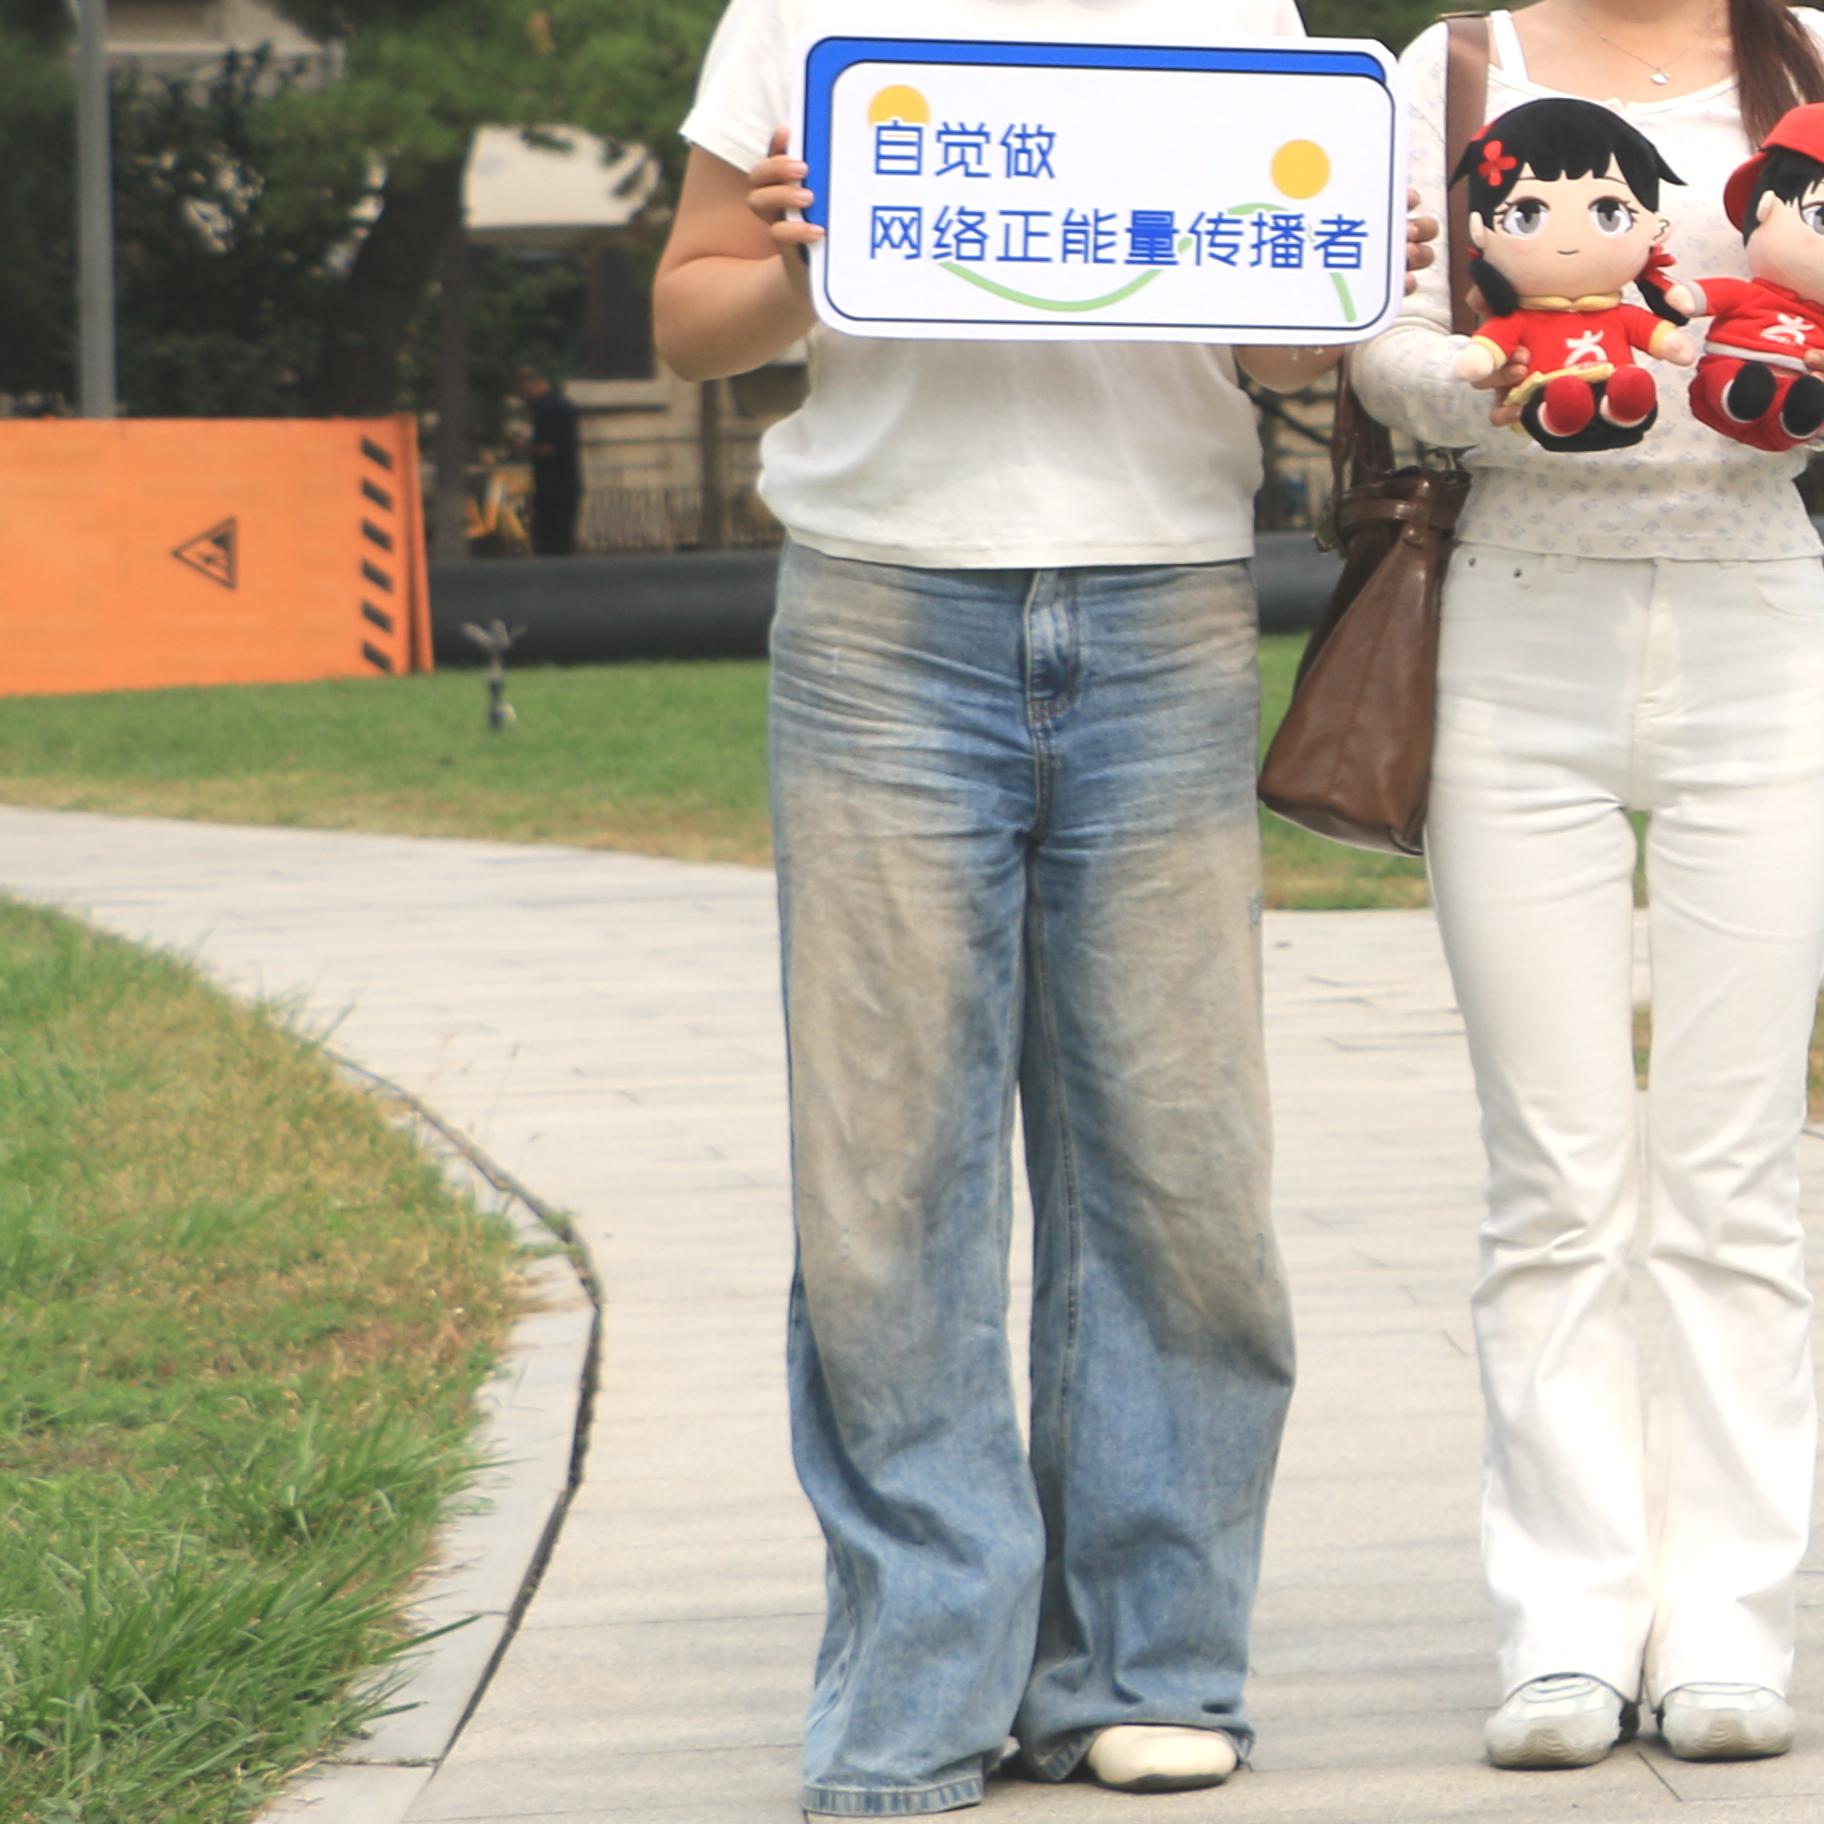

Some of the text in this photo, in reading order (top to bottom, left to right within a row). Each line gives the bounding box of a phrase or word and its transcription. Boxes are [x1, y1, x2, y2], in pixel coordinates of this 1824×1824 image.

[874, 120, 1057, 179] 自觉做
[869, 205, 1369, 270] 网络正能量传播者
